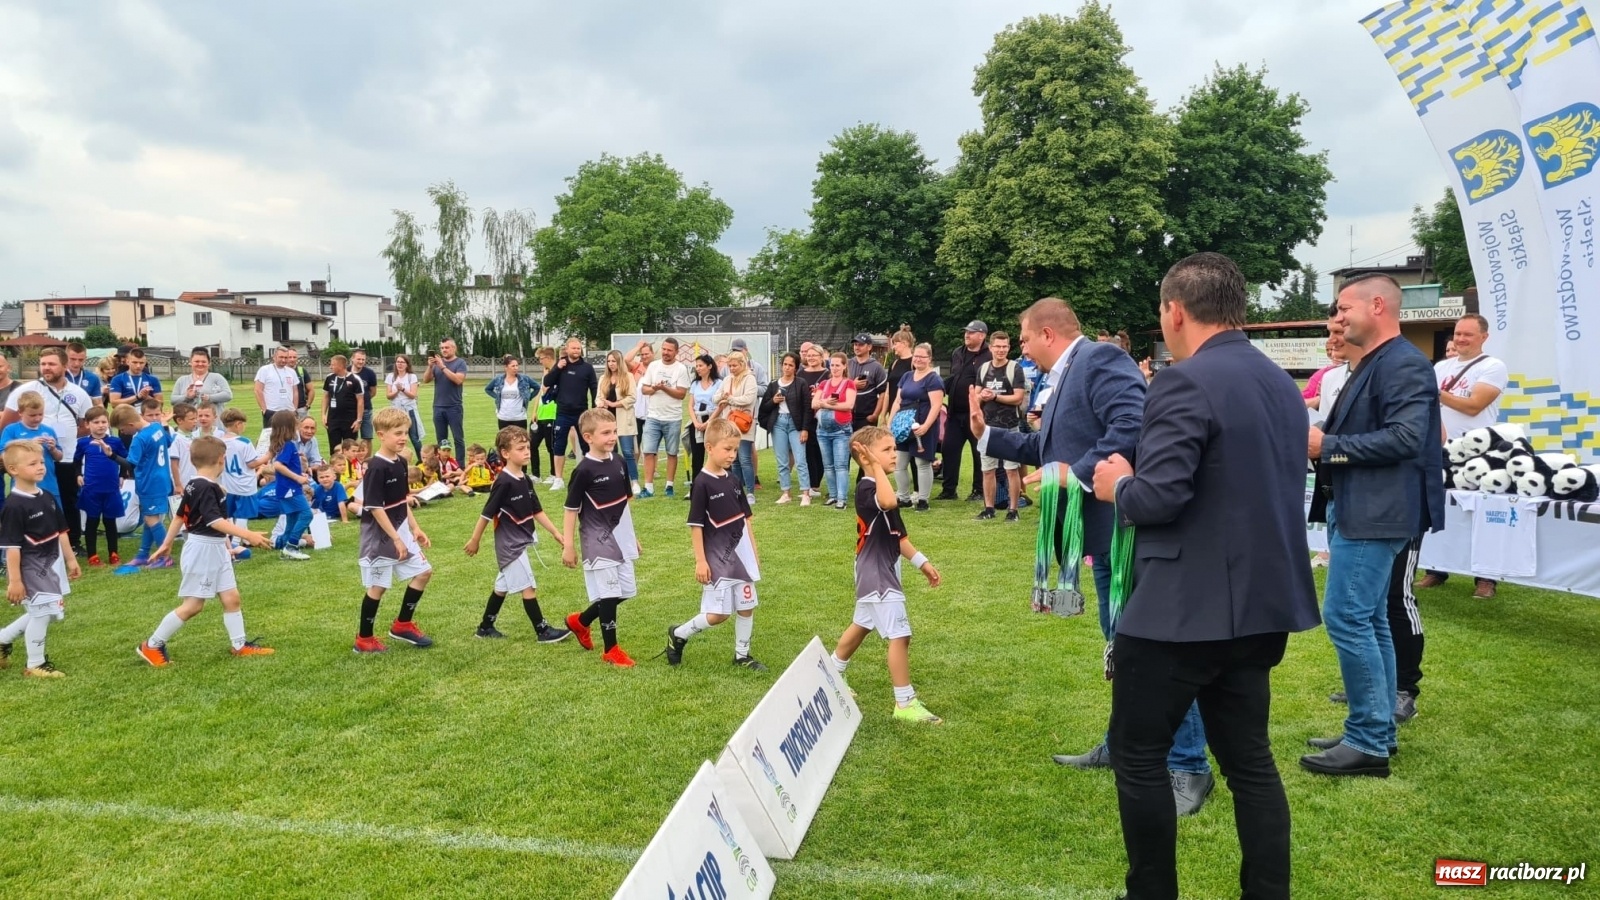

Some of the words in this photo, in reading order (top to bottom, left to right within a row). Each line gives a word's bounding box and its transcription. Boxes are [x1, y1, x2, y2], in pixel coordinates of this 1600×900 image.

[673, 310, 723, 325] safer
[1412, 307, 1464, 318] TWORKÓW
[743, 585, 752, 599] 9
[779, 693, 823, 778] TWORKÓW
[813, 686, 833, 727] CUP
